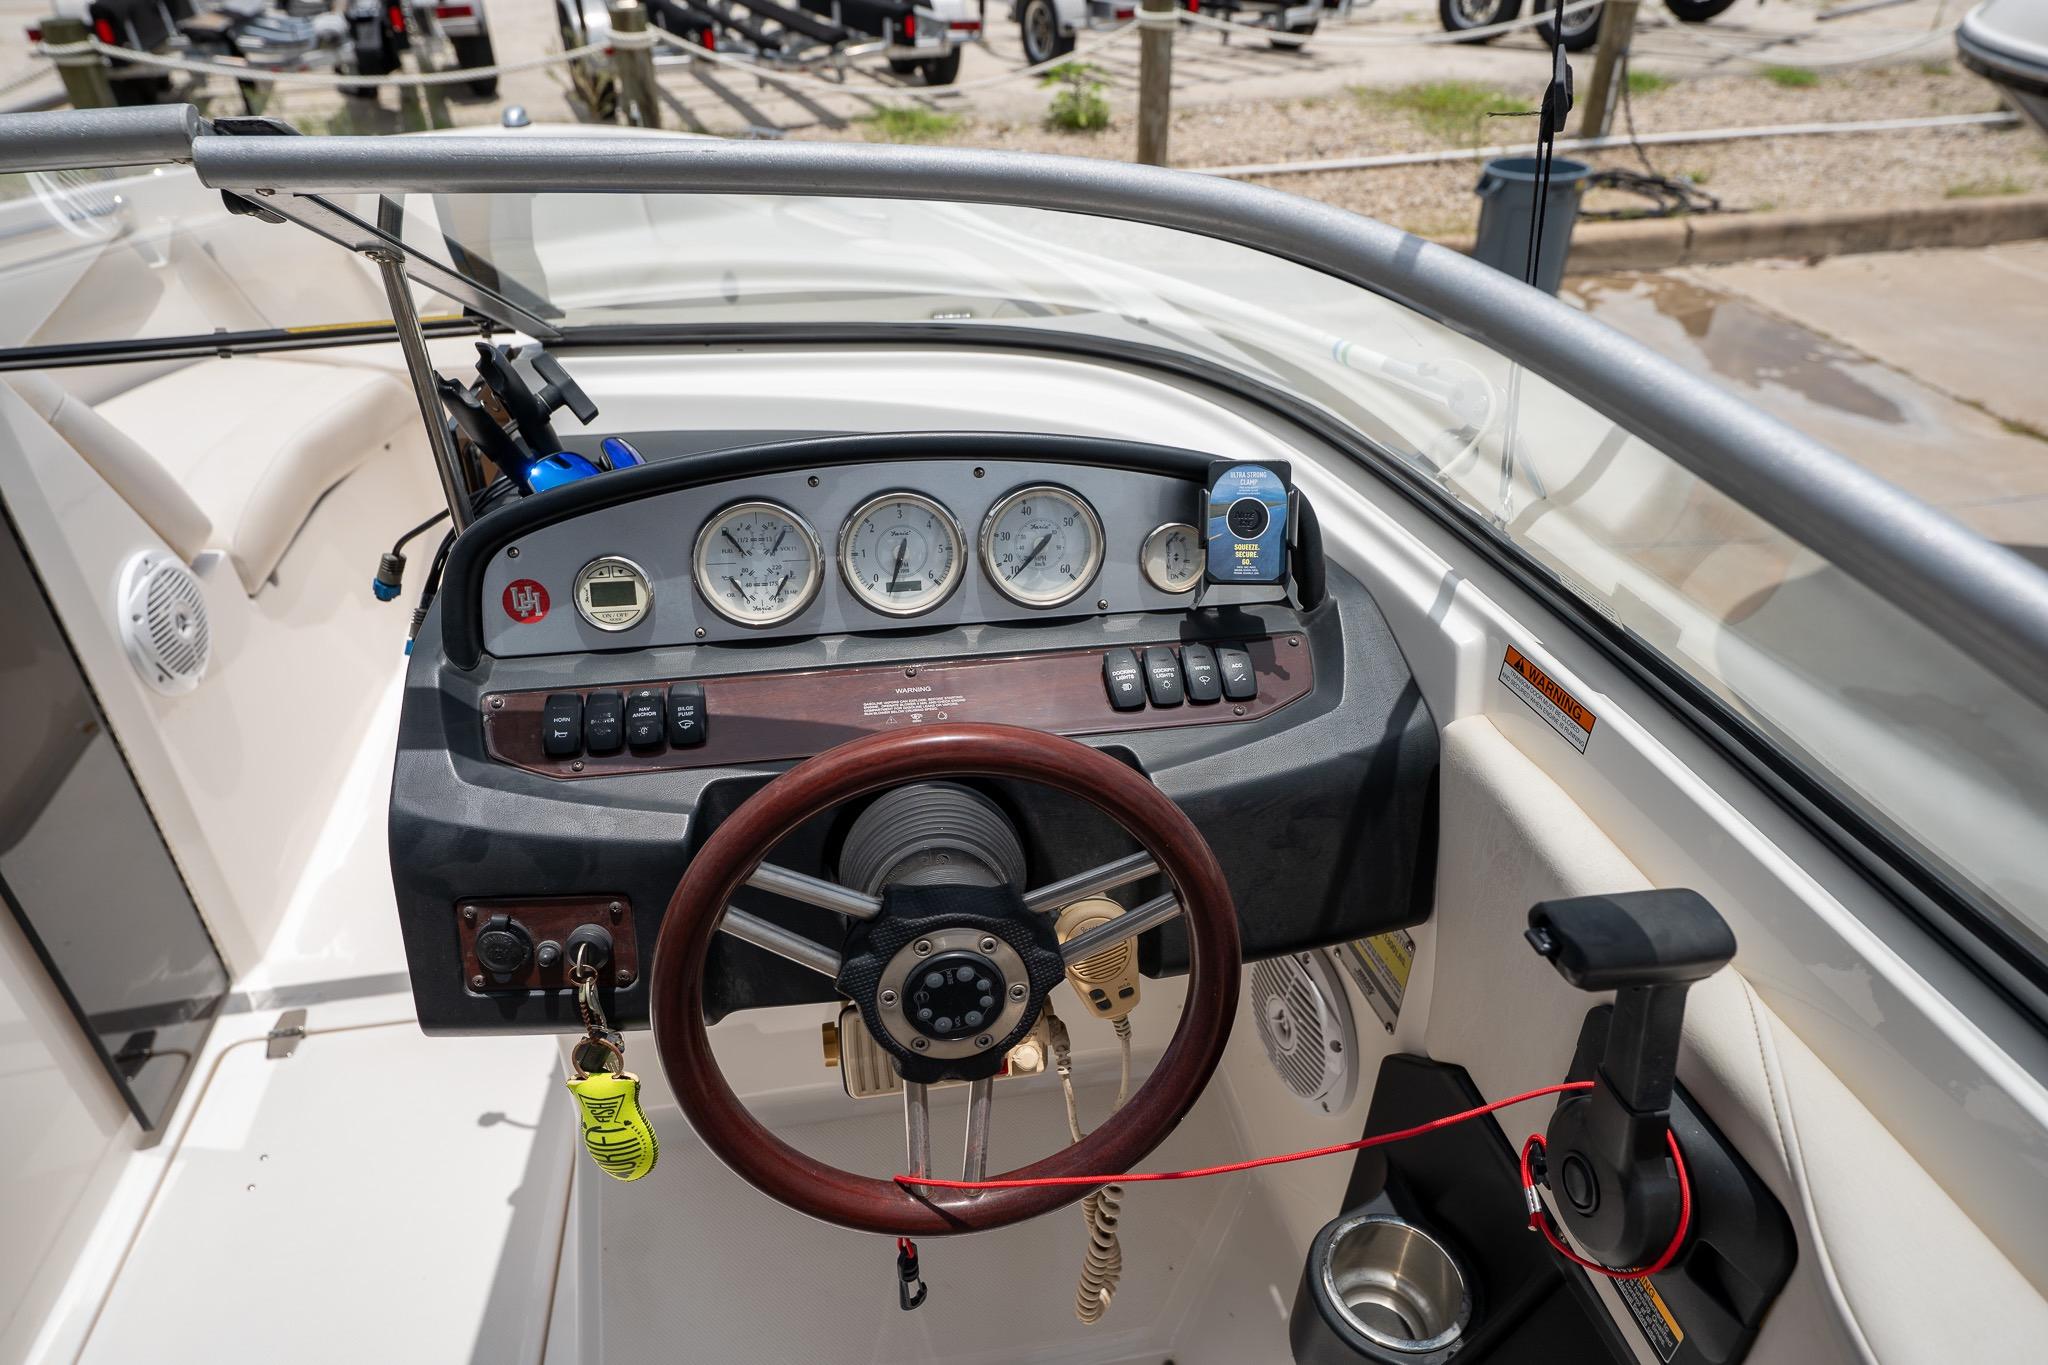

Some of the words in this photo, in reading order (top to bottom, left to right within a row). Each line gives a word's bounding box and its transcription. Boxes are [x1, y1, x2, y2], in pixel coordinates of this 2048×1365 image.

[897, 509, 903, 519] 3
[1021, 507, 1032, 516] 40
[926, 520, 932, 529] 4
[1063, 517, 1074, 527] 50
[869, 523, 875, 533] 2
[1000, 532, 1011, 541] 30
[861, 549, 866, 558] 1
[938, 544, 944, 554] 5
[1003, 554, 1013, 563] 20
[1010, 566, 1020, 575] 10
[1060, 564, 1071, 574] 60
[873, 573, 879, 583] 0
[928, 570, 934, 579] 6
[896, 686, 932, 694] WARNING
[1529, 666, 1583, 721] WARNING
[1501, 670, 1510, 682] AND
[1529, 695, 1543, 711] WHEN
[1563, 725, 1585, 748] RUNNING
[1529, 686, 1543, 701] DOOR
[1554, 708, 1561, 717] BE
[1560, 713, 1580, 734] CLOSED
[585, 1101, 618, 1123] FISH
[1652, 1314, 1673, 1347] Qualified
[1662, 1322, 1670, 1332] to
